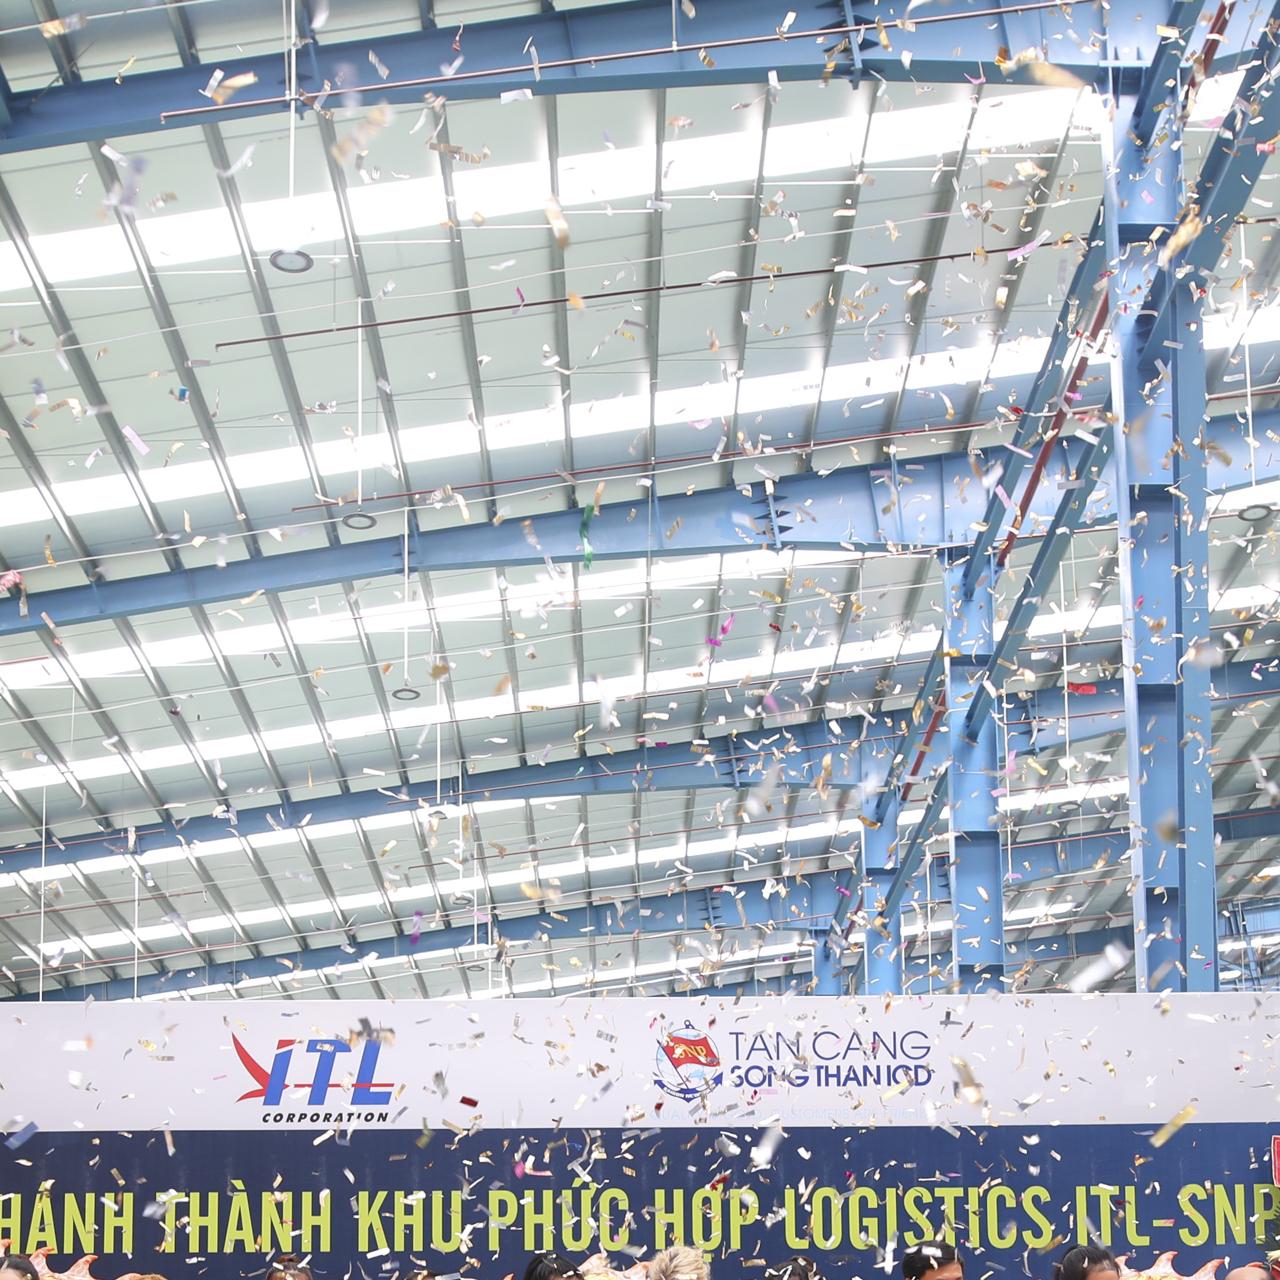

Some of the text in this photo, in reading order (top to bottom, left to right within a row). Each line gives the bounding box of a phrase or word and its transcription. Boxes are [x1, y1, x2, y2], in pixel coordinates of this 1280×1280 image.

[262, 1039, 393, 1106] ITL
[261, 1111, 389, 1124] CORPORATION
[155, 1179, 331, 1253] THÀNH
[357, 1190, 463, 1253] KHU
[784, 1185, 1053, 1250] LOGISTICS
